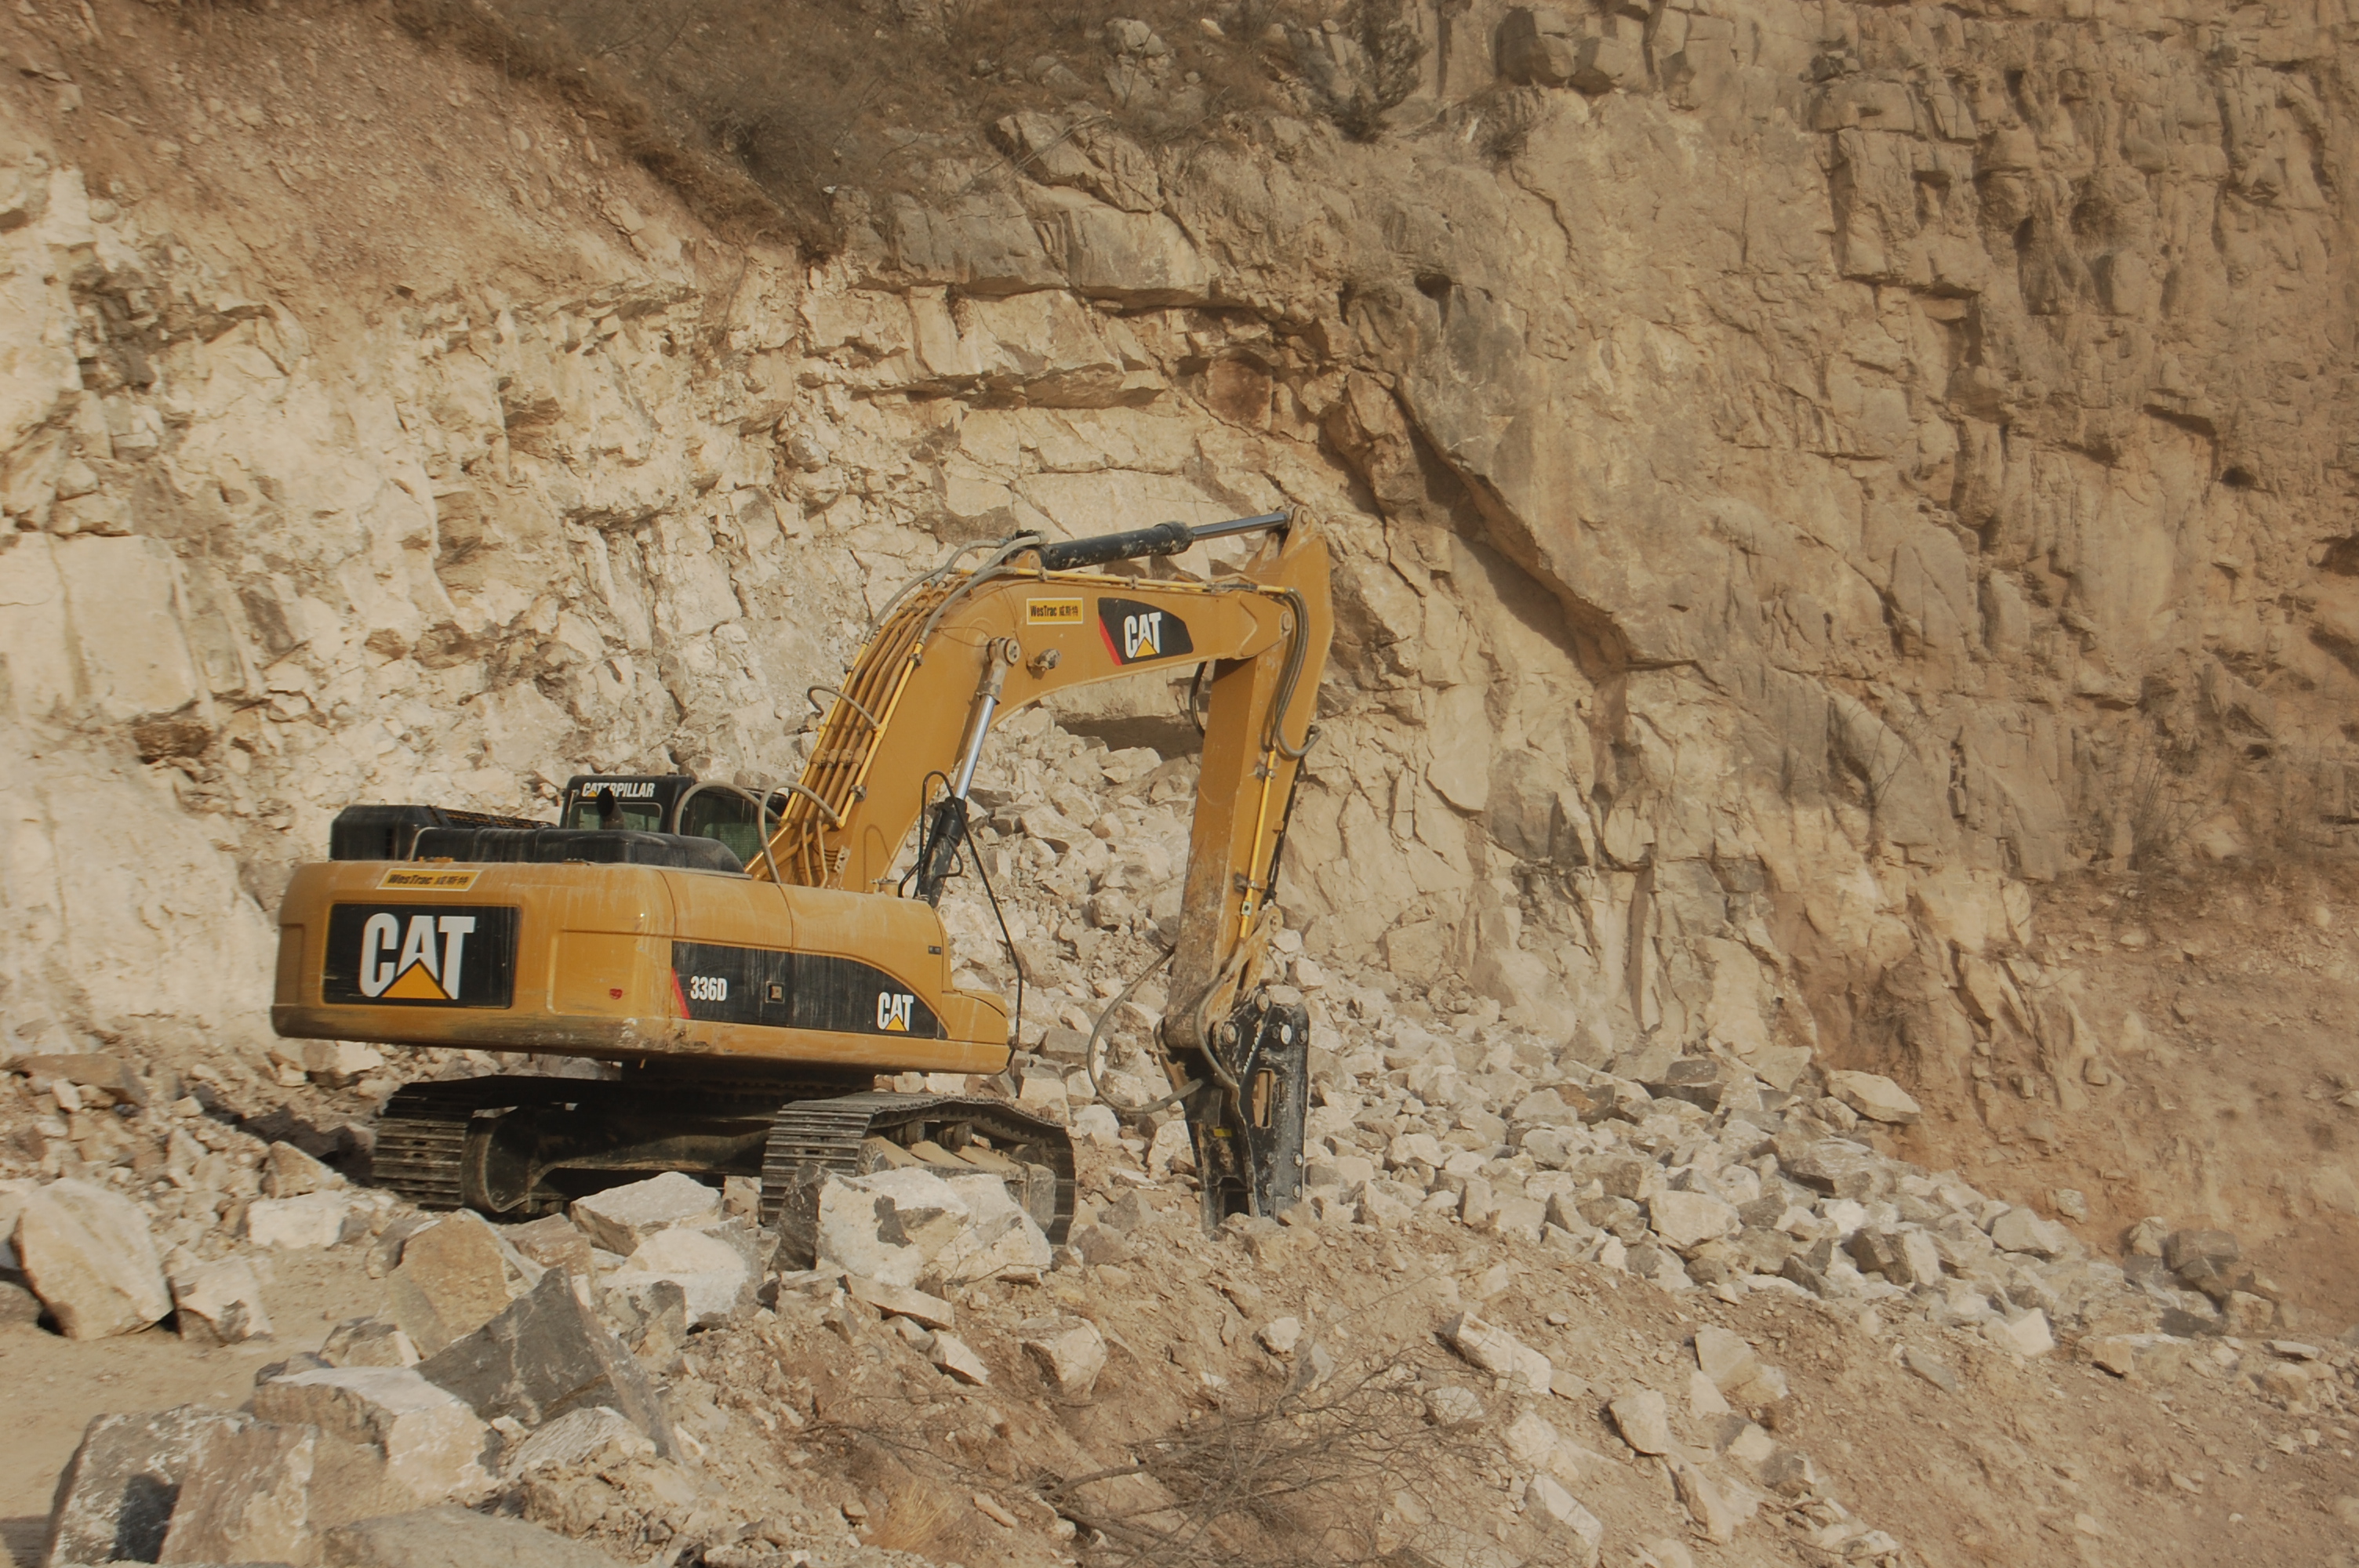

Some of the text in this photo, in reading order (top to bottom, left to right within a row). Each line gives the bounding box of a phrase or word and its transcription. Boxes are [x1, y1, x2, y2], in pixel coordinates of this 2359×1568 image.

[1030, 605, 1057, 617] WesTrac
[1124, 612, 1162, 659] CAT
[387, 874, 433, 885] WesTrac
[359, 913, 476, 1000] CAT
[690, 975, 728, 1002] 336D
[877, 992, 914, 1033] CAT
